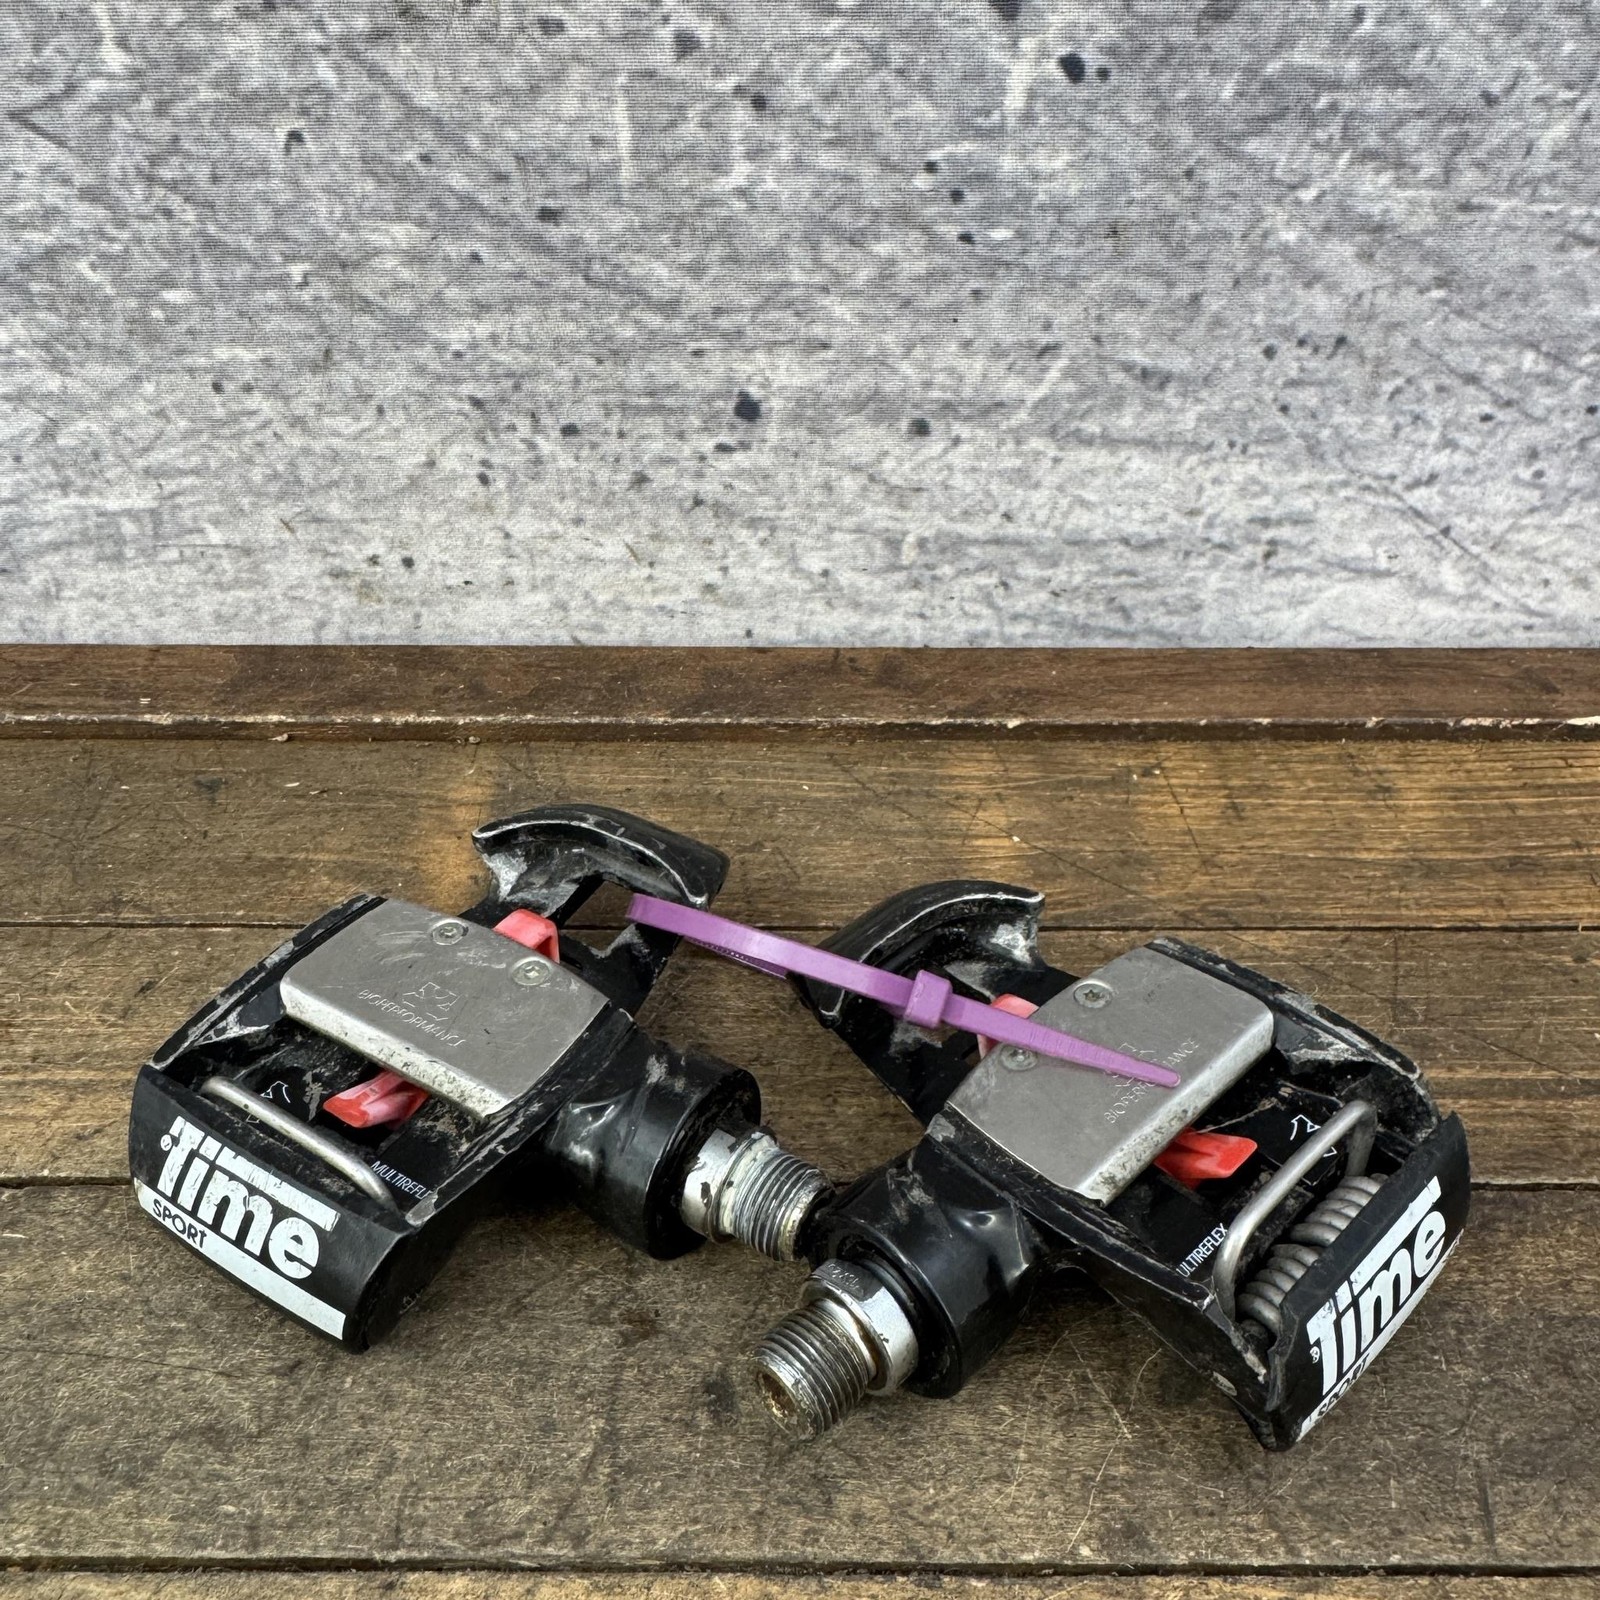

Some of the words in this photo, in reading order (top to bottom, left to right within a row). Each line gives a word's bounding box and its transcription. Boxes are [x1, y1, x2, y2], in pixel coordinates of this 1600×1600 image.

[1104, 1038, 1199, 1123] BIOPERFANCE
[371, 1161, 431, 1200] MULTIREFL
[152, 1199, 207, 1248] SPORT
[1176, 1223, 1228, 1278] ULTIREFLEX
